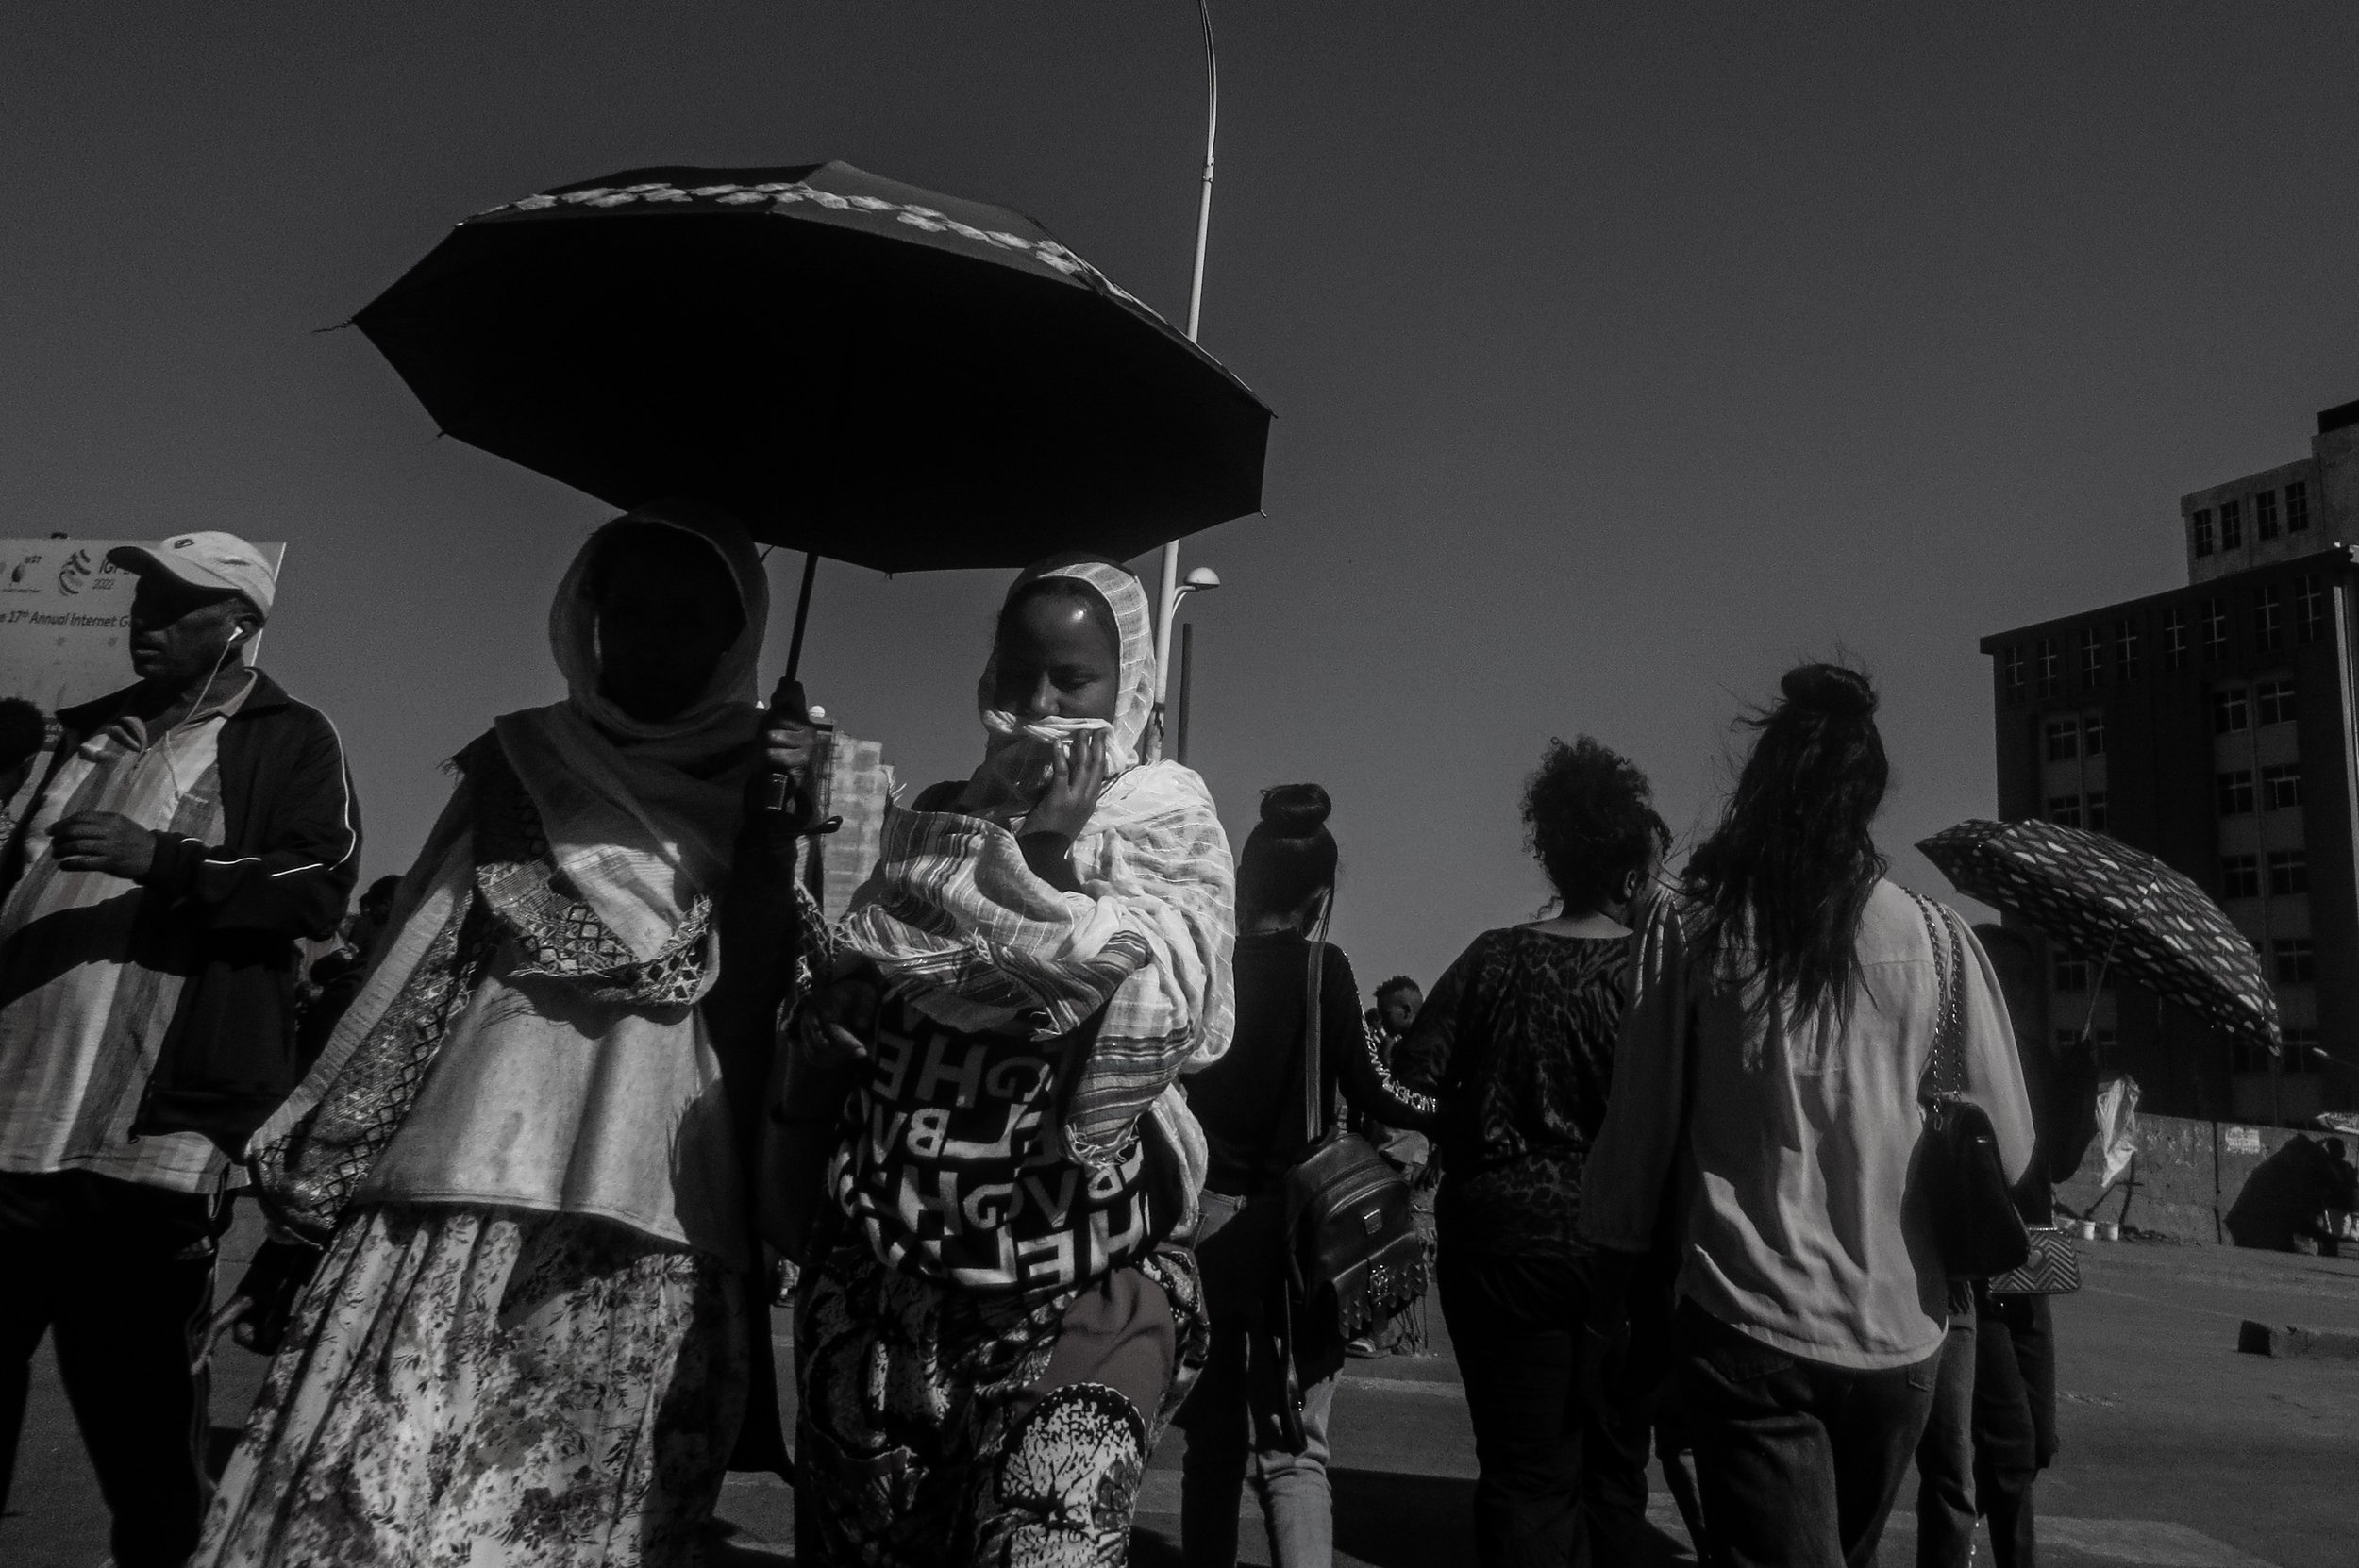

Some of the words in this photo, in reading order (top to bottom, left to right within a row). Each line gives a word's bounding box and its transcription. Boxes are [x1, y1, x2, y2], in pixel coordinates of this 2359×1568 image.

[99, 559, 119, 574] IG
[8, 609, 29, 624] 17th
[29, 611, 69, 626] Annual
[70, 612, 117, 629] Internet
